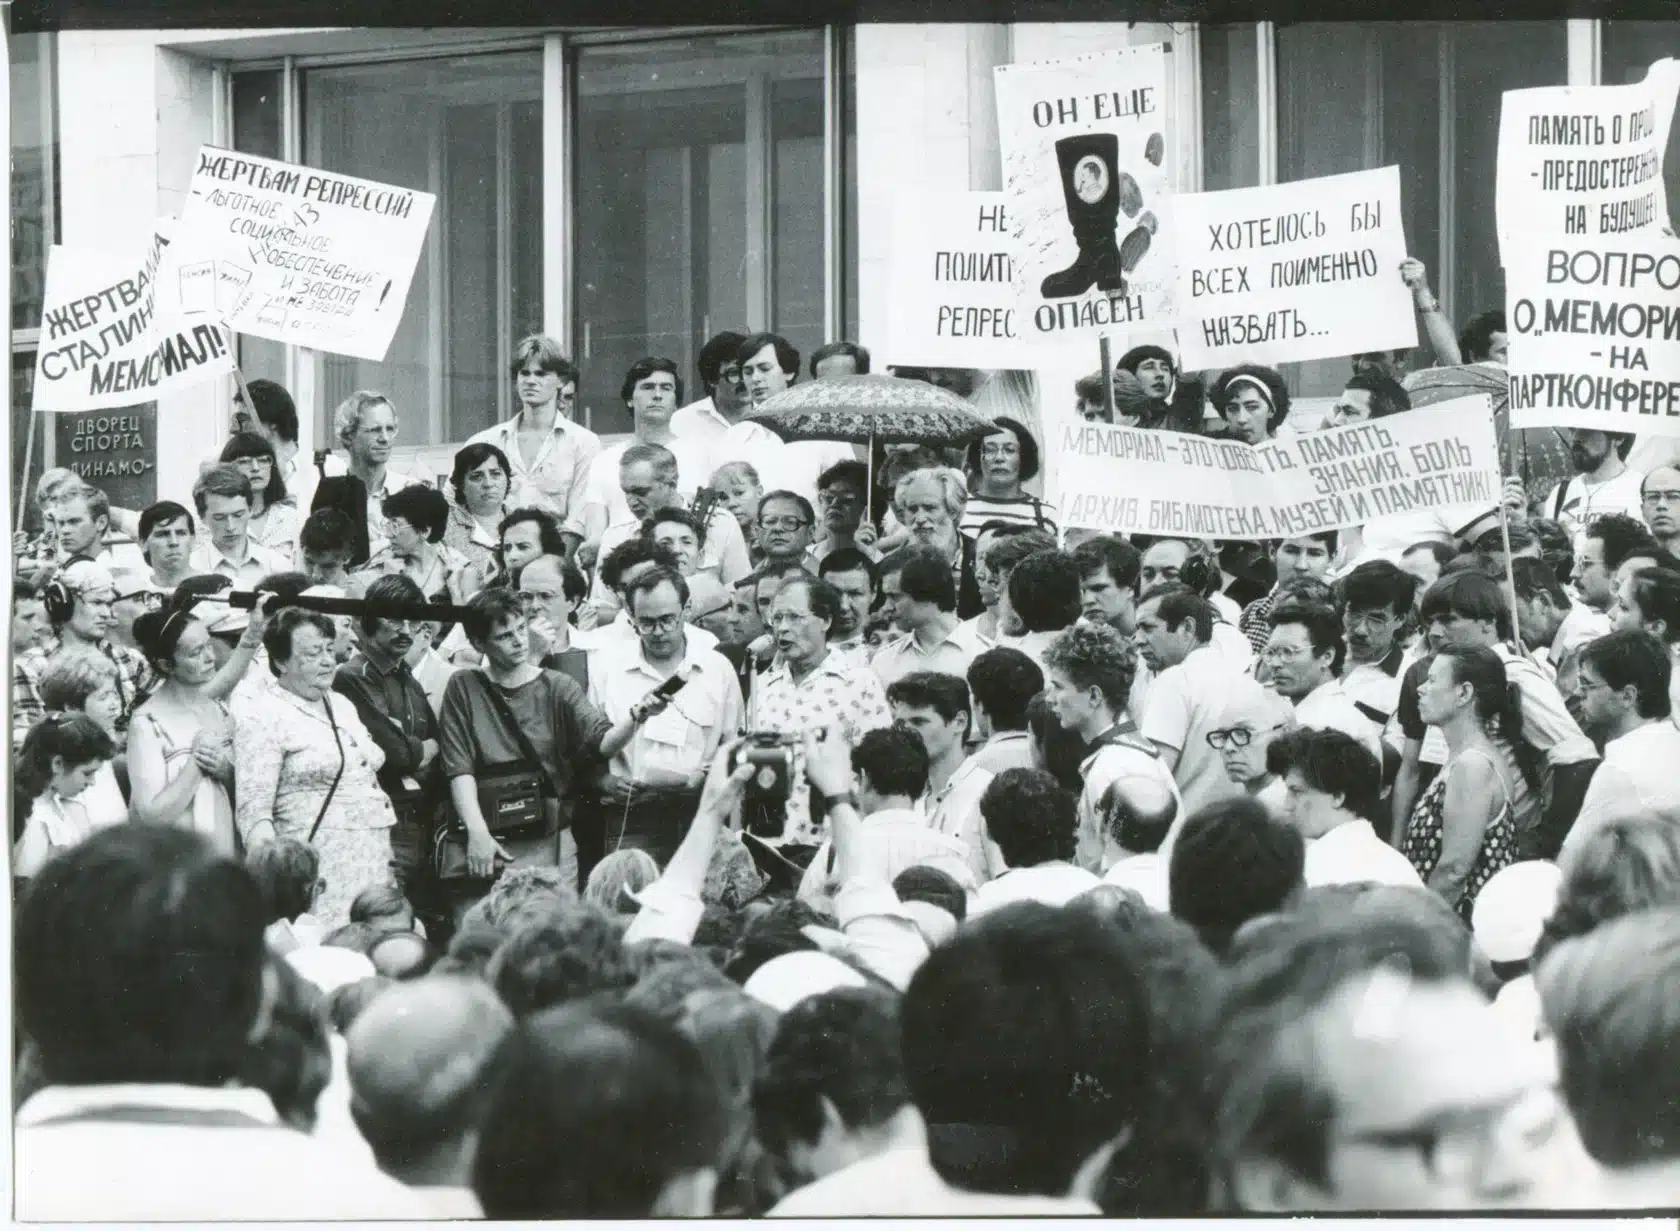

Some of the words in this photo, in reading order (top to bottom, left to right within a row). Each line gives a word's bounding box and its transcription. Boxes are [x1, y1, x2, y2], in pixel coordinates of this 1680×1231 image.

[1032, 97, 1079, 129] ОН
[1093, 87, 1157, 122] ЕЩЕ
[1528, 114, 1605, 146] ПАМЯТЬ
[1611, 114, 1622, 145] О
[196, 152, 301, 195] ЖЕРТВАМ
[303, 175, 414, 219] РЕПРЕССИЙ
[204, 188, 284, 220] ЛЬГОТНОЕ
[1208, 210, 1327, 252] ХОТЕЛОСЬ
[1350, 199, 1382, 232] БЫ
[1564, 204, 1587, 235] НА
[280, 274, 295, 290] И
[296, 276, 361, 305] ЗАБОТА
[1192, 265, 1252, 298] ВСЕХ
[1270, 248, 1379, 289] ПОИМЕННО
[1546, 249, 1680, 291] ВОПРО
[1034, 294, 1145, 332] ОПАСЕН
[1201, 308, 1330, 348] НАЗВАТЬ...
[1609, 345, 1649, 371] НА
[1510, 373, 1680, 417] ПАРТКОНФЕРЕ
[71, 432, 145, 452] СПОРТА
[75, 415, 141, 435] ДВОРЕЦ
[1409, 435, 1473, 475] БОЛЬ
[1274, 491, 1350, 535] МУЗЕЙ
[1350, 490, 1372, 520] И
